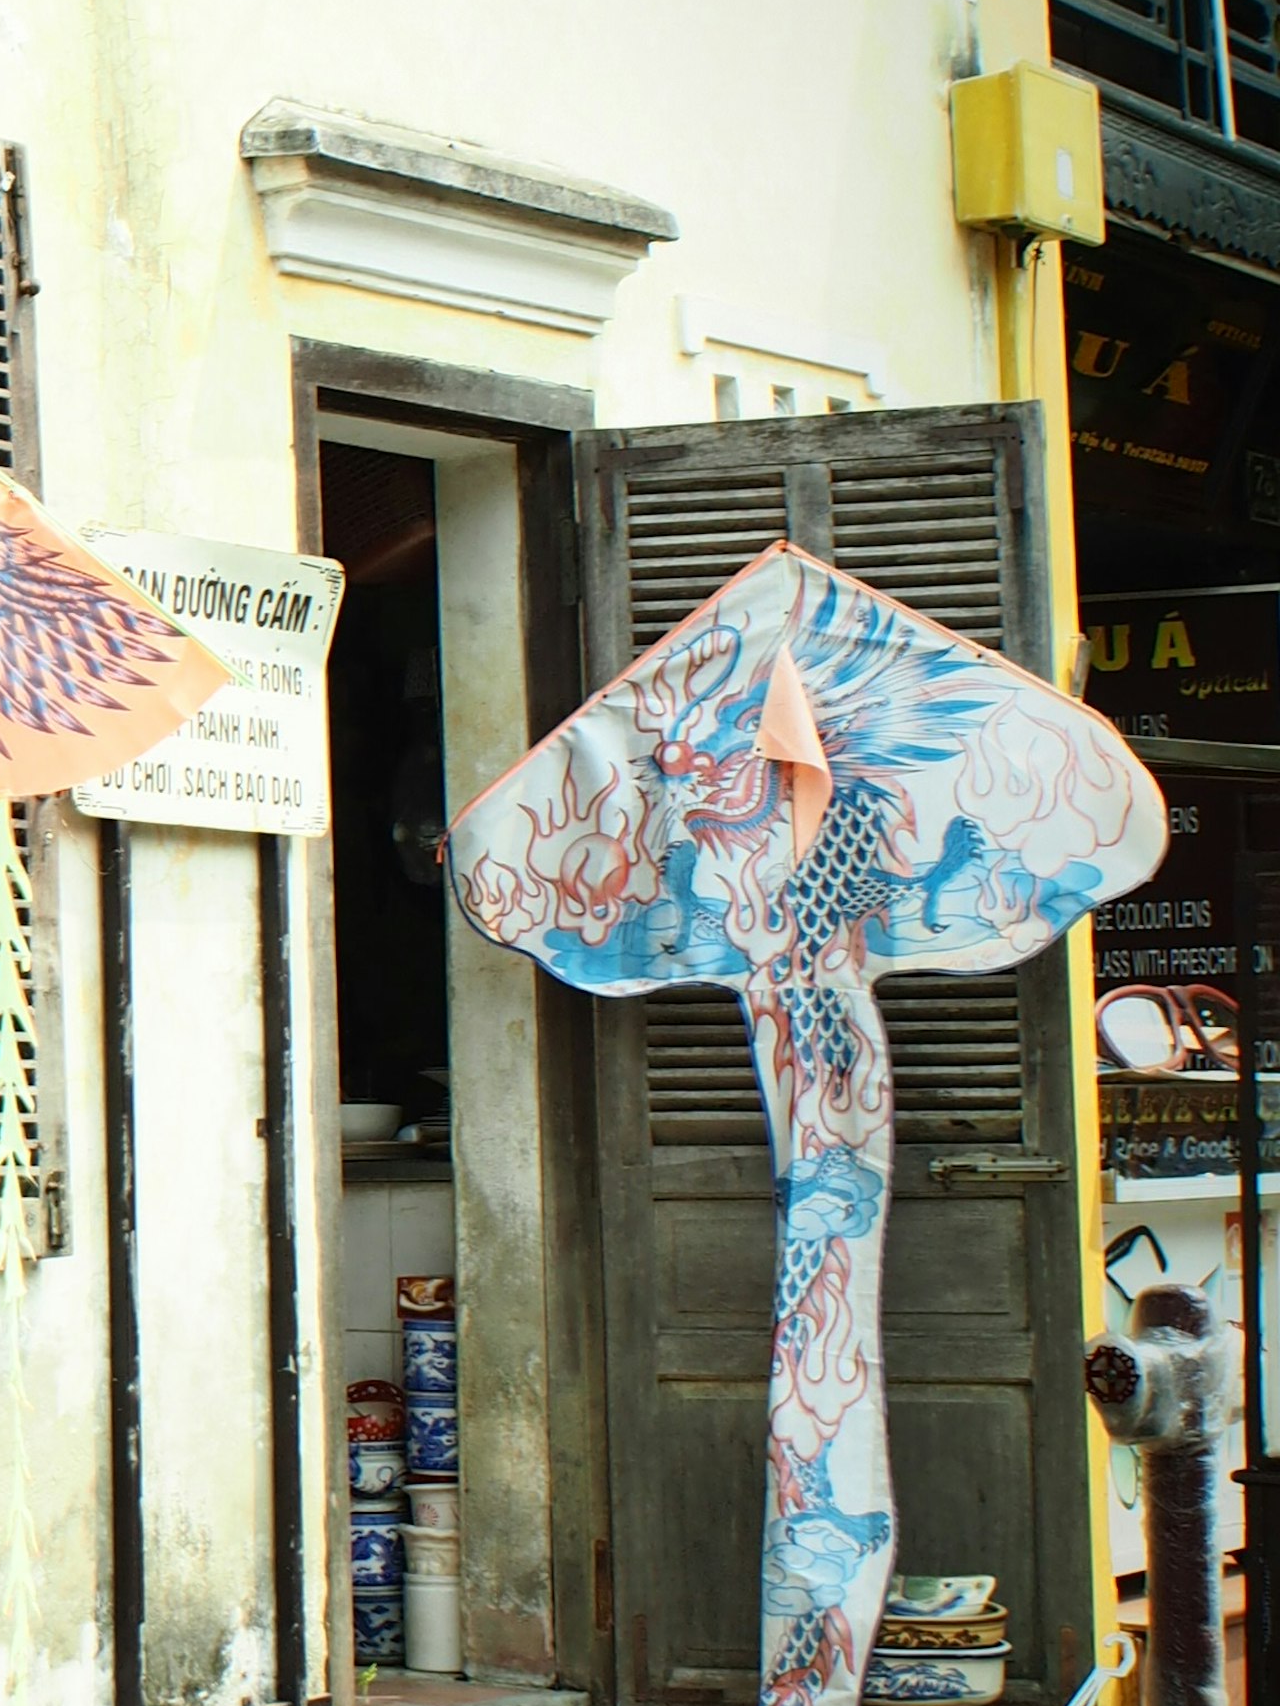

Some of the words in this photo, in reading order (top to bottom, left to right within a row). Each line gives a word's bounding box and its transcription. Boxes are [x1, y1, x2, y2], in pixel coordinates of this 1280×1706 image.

[174, 566, 251, 625] ĐƯỜNG
[1115, 901, 1171, 931] COLOUR
[1174, 899, 1212, 929] LENS
[1131, 948, 1167, 977] WITH
